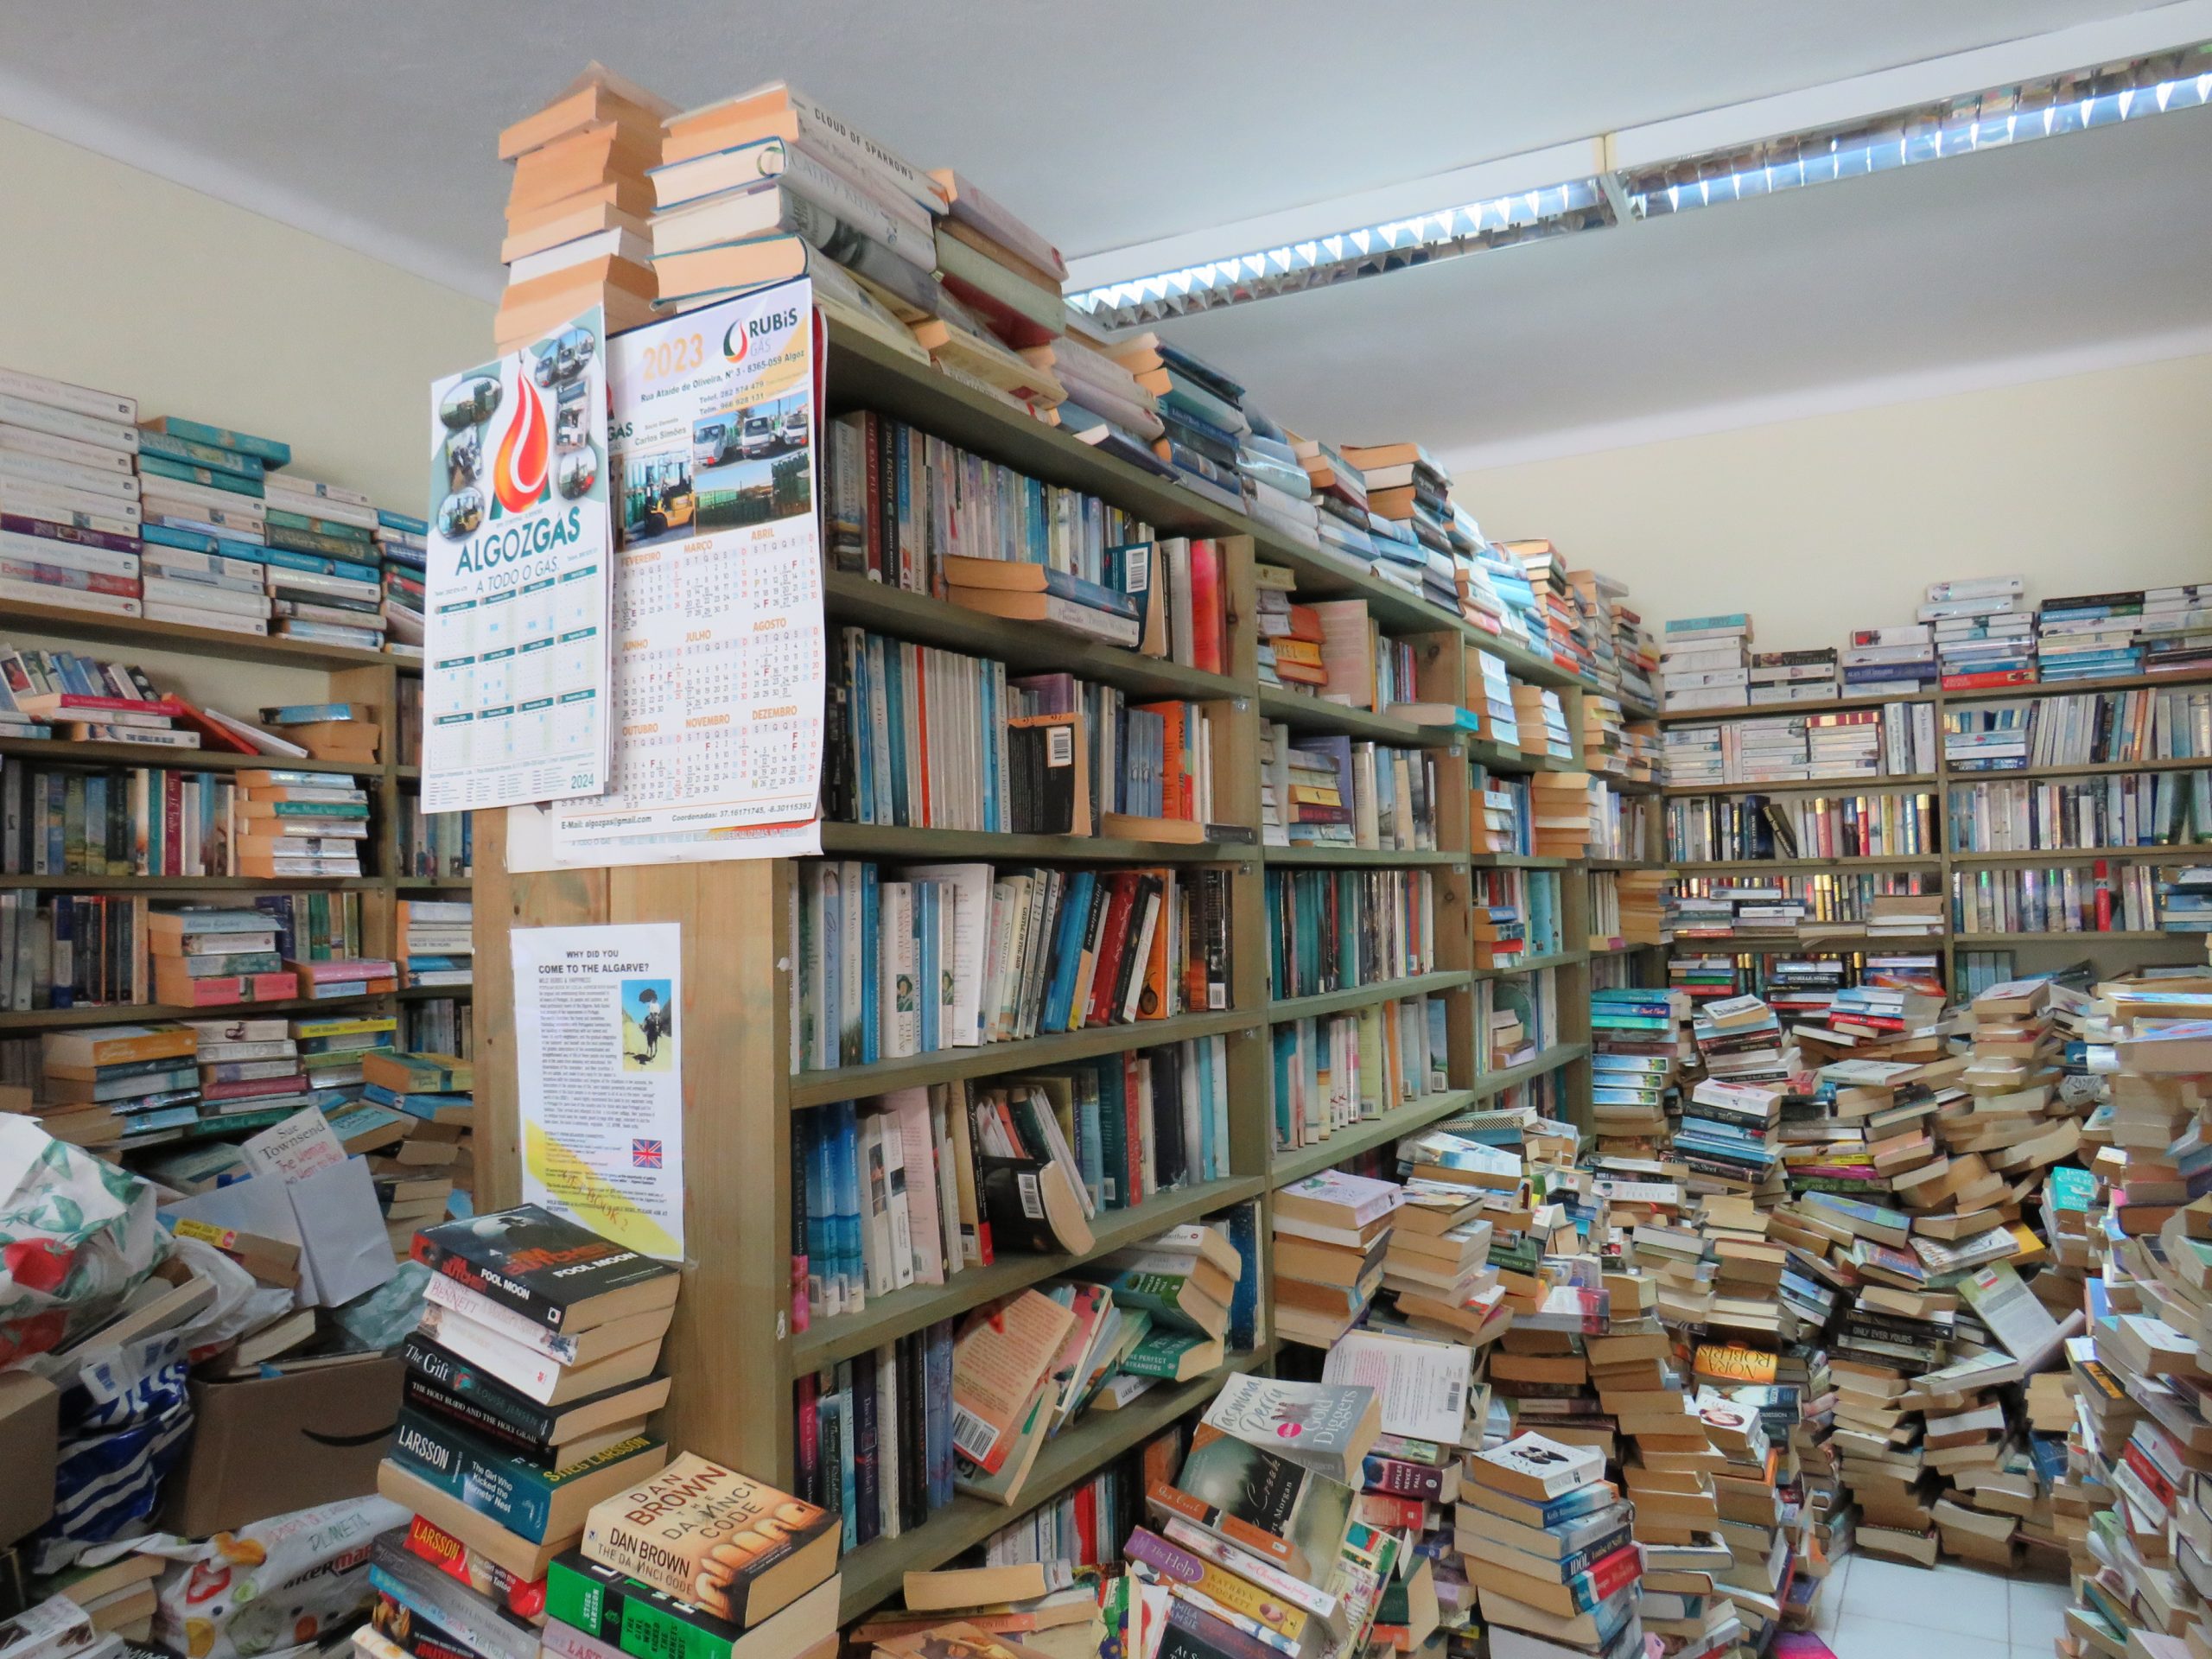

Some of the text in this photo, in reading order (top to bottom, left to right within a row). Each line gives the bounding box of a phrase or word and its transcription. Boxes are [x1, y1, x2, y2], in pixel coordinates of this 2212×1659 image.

[814, 107, 914, 181] CLOUD OF SPARROWS
[749, 308, 798, 338] RUBiS
[642, 333, 704, 381] 2023
[640, 389, 655, 403] Rua
[682, 381, 691, 392] de
[692, 374, 723, 389] Oliveira,
[735, 367, 741, 378] 3
[784, 349, 805, 363] Algoz
[720, 389, 733, 398] 282
[751, 380, 765, 391] 479
[735, 396, 749, 407] 928
[751, 392, 765, 403] 131
[634, 433, 658, 447] Carlos
[659, 425, 687, 441] Simões
[455, 505, 581, 577] ALGOZGÁS
[683, 539, 713, 554] MARÇO
[751, 528, 775, 541] ABRIL
[620, 551, 661, 567] FEVEREIRO
[475, 564, 532, 594] A TODO O
[685, 630, 712, 642] JULHO
[753, 618, 787, 632] AGOSTO
[623, 639, 648, 652] JUNHO
[685, 714, 730, 728] NOVEMBRO
[752, 705, 798, 720] DEZEMBRO
[622, 723, 658, 736] OUTUBRO
[570, 772, 594, 790] 2024
[562, 819, 584, 830] E-Mail:
[671, 811, 718, 822] Coordenadas:
[1020, 906, 1028, 932] CASTLE
[602, 950, 619, 958] YOU
[1015, 955, 1024, 970] SUN
[538, 963, 649, 974] COME TO THE ALGARVE?
[259, 1119, 326, 1160] Townsend
[276, 1122, 299, 1139] Sue
[552, 1251, 639, 1279] FOOL MOON
[480, 1268, 531, 1300] FOOL MOON
[431, 1281, 479, 1314] BENNETT
[1853, 1325, 1914, 1345] ONLY EVER YOURS
[404, 1342, 423, 1364] The
[423, 1351, 451, 1382] Gift
[1136, 1354, 1166, 1363] PERFECT
[1698, 1344, 1772, 1369] ROBERTS
[1707, 1358, 1757, 1379] NORA
[412, 1382, 538, 1444] THE HOLY AND THE HOLY GRAIL
[505, 1401, 538, 1425] JENSEN
[1211, 1379, 1262, 1433] Tasmina
[1239, 1388, 1292, 1433] Perry
[1301, 1398, 1334, 1432] Gold
[1313, 1390, 1359, 1446] Diggers
[397, 1424, 450, 1470] LARSSON
[864, 1396, 874, 1495] David Mitchell
[543, 1436, 652, 1483] STIEG LARSSON
[471, 1460, 513, 1491] The Girl Who
[472, 1473, 509, 1500] Kicked the
[629, 1473, 683, 1503] DAN
[1394, 1464, 1403, 1490] APPLES
[1403, 1468, 1412, 1491] NEVER
[494, 1495, 512, 1514] Nest
[625, 1465, 728, 1527] BROWN
[1274, 1480, 1293, 1521] Morgan
[662, 1522, 698, 1541] DA
[700, 1501, 763, 1540] CODE
[412, 1520, 461, 1562] LARSSON
[609, 1528, 691, 1579] DAN BROWN
[483, 1561, 518, 1585] Girl with the
[597, 1543, 615, 1560] THE
[618, 1553, 632, 1566] DA
[664, 1574, 694, 1595] CODE
[1151, 1545, 1196, 1579] The Help
[1569, 1556, 1591, 1574] IDOL
[493, 1578, 512, 1592] Tattoo
[1207, 1582, 1251, 1610] STOCKETT
[1210, 1573, 1253, 1600] KATHRYN
[583, 1592, 592, 1618] STIEG
[589, 1588, 601, 1630] LARSSON
[626, 1616, 635, 1634] THE
[634, 1617, 644, 1642] GIRL
[643, 1620, 652, 1643] WHO
[651, 1621, 661, 1653] KICKED
[660, 1632, 669, 1650] THE
